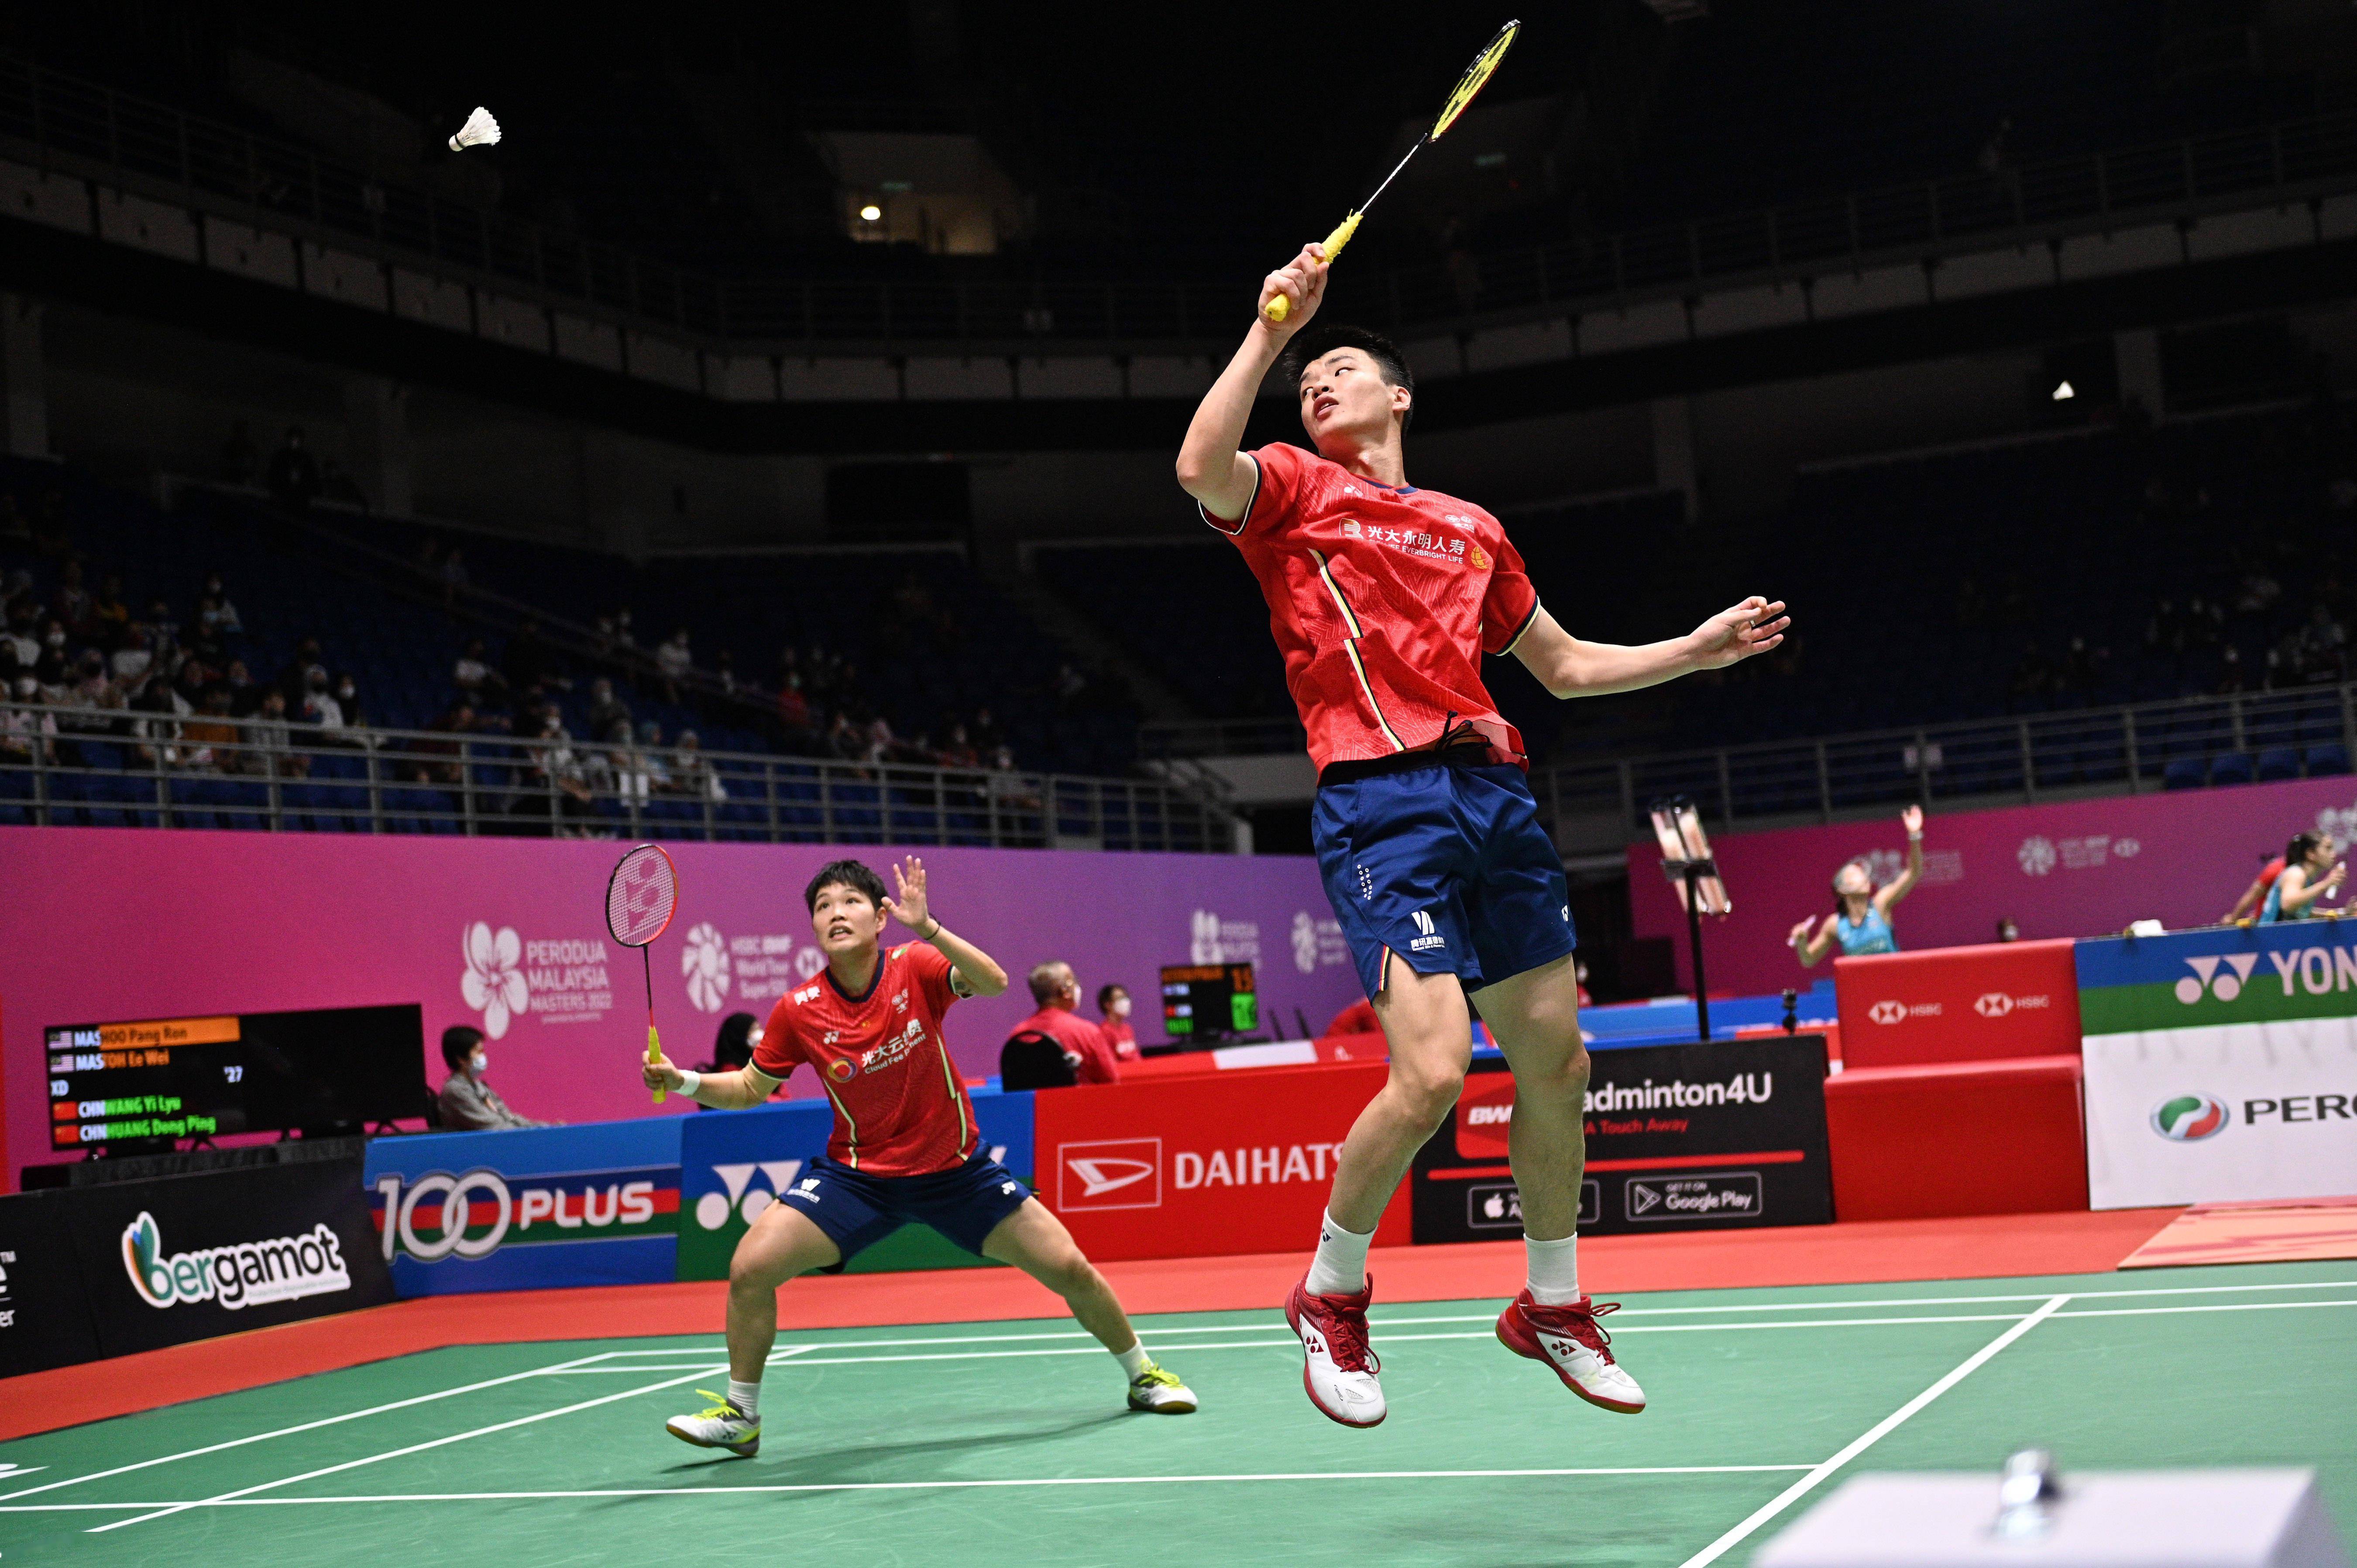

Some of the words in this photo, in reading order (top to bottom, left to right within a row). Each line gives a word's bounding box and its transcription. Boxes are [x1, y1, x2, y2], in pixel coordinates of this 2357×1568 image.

[1367, 526, 1465, 555] 光大永明人寿
[1402, 546, 1446, 560] EVERBRIGHT
[1448, 555, 1464, 564] LIFE
[527, 940, 608, 965] PERODUA
[528, 966, 609, 991] MALAYSIA
[530, 994, 588, 1012] MASTERS
[1910, 1003, 1942, 1016] HSBC
[2017, 995, 2049, 1009] HSBC
[74, 1030, 101, 1047] MAS
[76, 1053, 104, 1071] MAS
[865, 1060, 888, 1074] Cloud
[889, 1054, 904, 1065] Fee
[50, 1080, 69, 1097] XD
[1583, 1072, 1772, 1112] adminton4U
[78, 1100, 106, 1118] CHN
[105, 1097, 143, 1115] WANG
[1468, 1105, 1513, 1125] BW
[2244, 1094, 2357, 1126] PER
[80, 1123, 107, 1141] CHN
[186, 1115, 216, 1134] Ping
[1584, 1121, 1597, 1134] A
[1599, 1118, 1644, 1134] Touch
[1646, 1117, 1690, 1133] Away
[1665, 1192, 1719, 1212] Google
[1721, 1190, 1752, 1210] Play
[378, 1172, 512, 1260] 100
[520, 1181, 654, 1231] PLUS
[127, 1219, 341, 1302] bergamot
